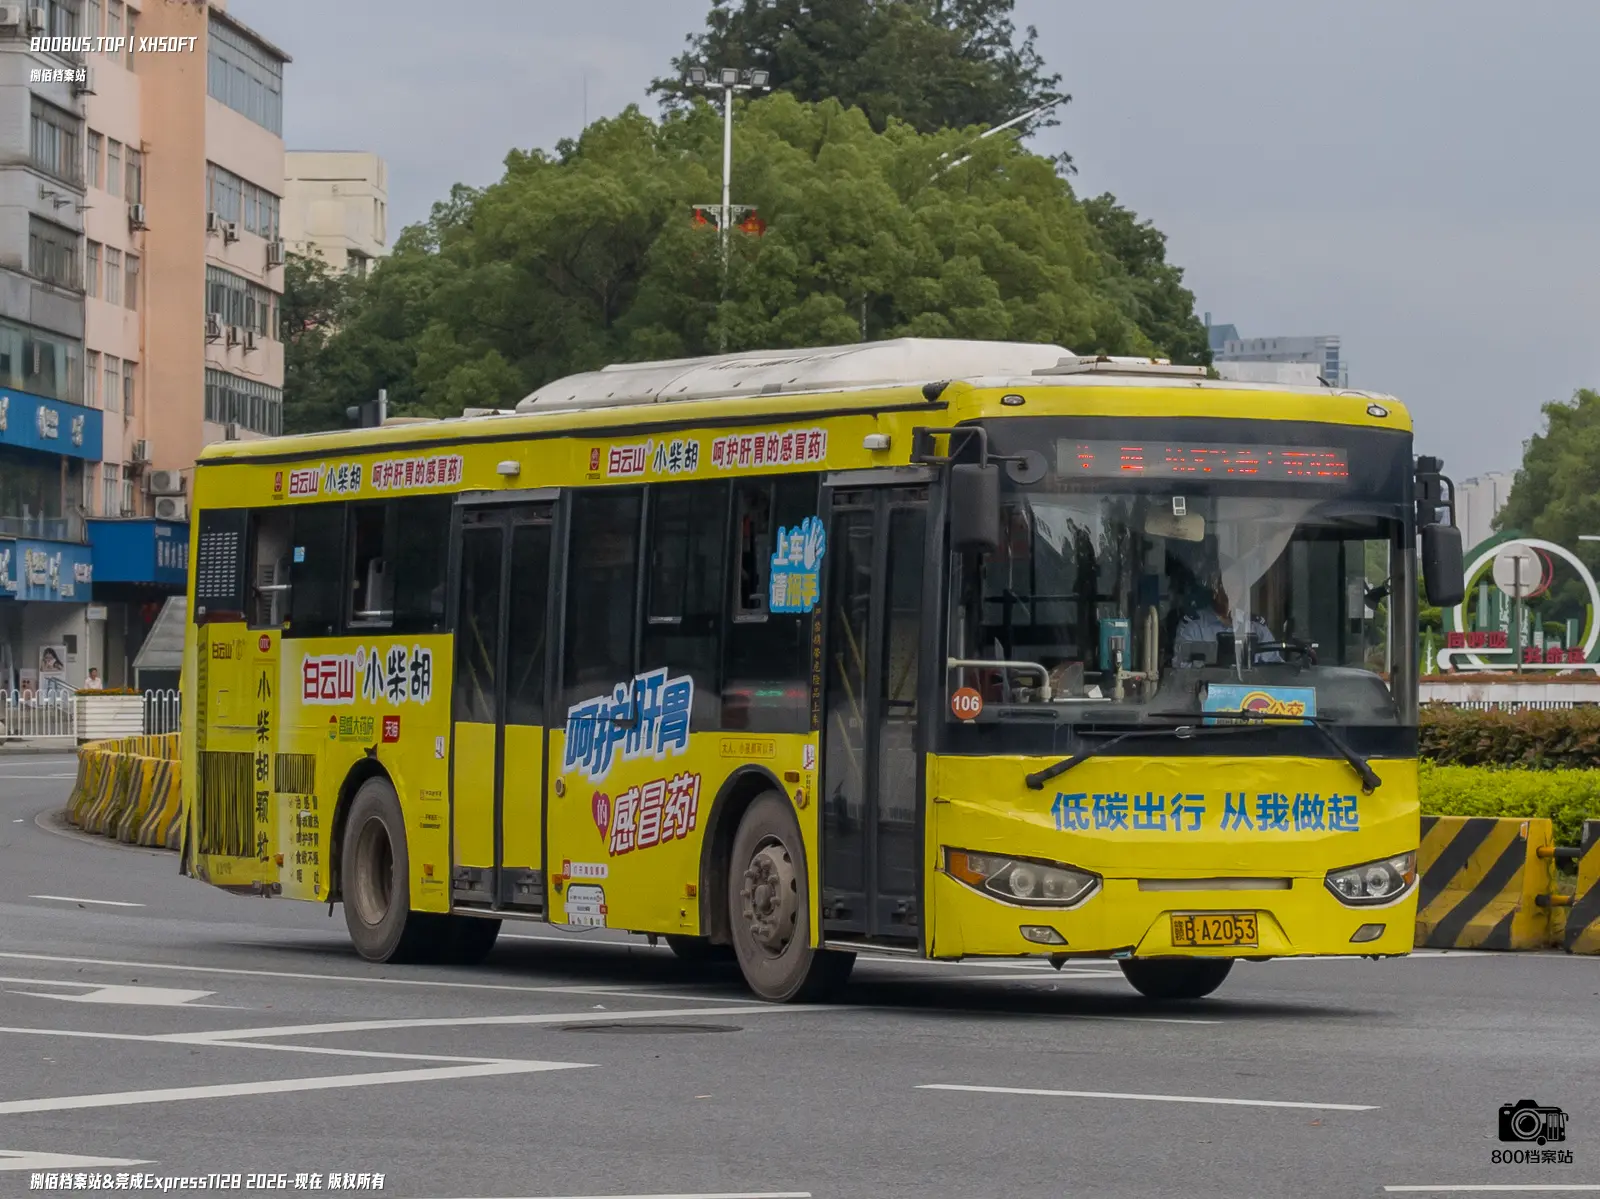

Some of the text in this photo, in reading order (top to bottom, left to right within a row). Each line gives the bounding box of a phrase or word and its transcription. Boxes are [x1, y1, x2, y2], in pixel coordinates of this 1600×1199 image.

[289, 470, 319, 494] 白云山
[325, 465, 361, 493] 小柴胡
[609, 448, 646, 474] 白云山
[653, 441, 698, 473] 小柴胡
[303, 649, 431, 702] 白云山 小柴胡
[564, 671, 692, 776] 呵护肝胃
[953, 695, 980, 711] 106
[256, 670, 271, 863] 小柴胡颗粒
[596, 772, 701, 853] 的 感冒药!
[1050, 791, 1361, 832] 低碳出行 从我做起
